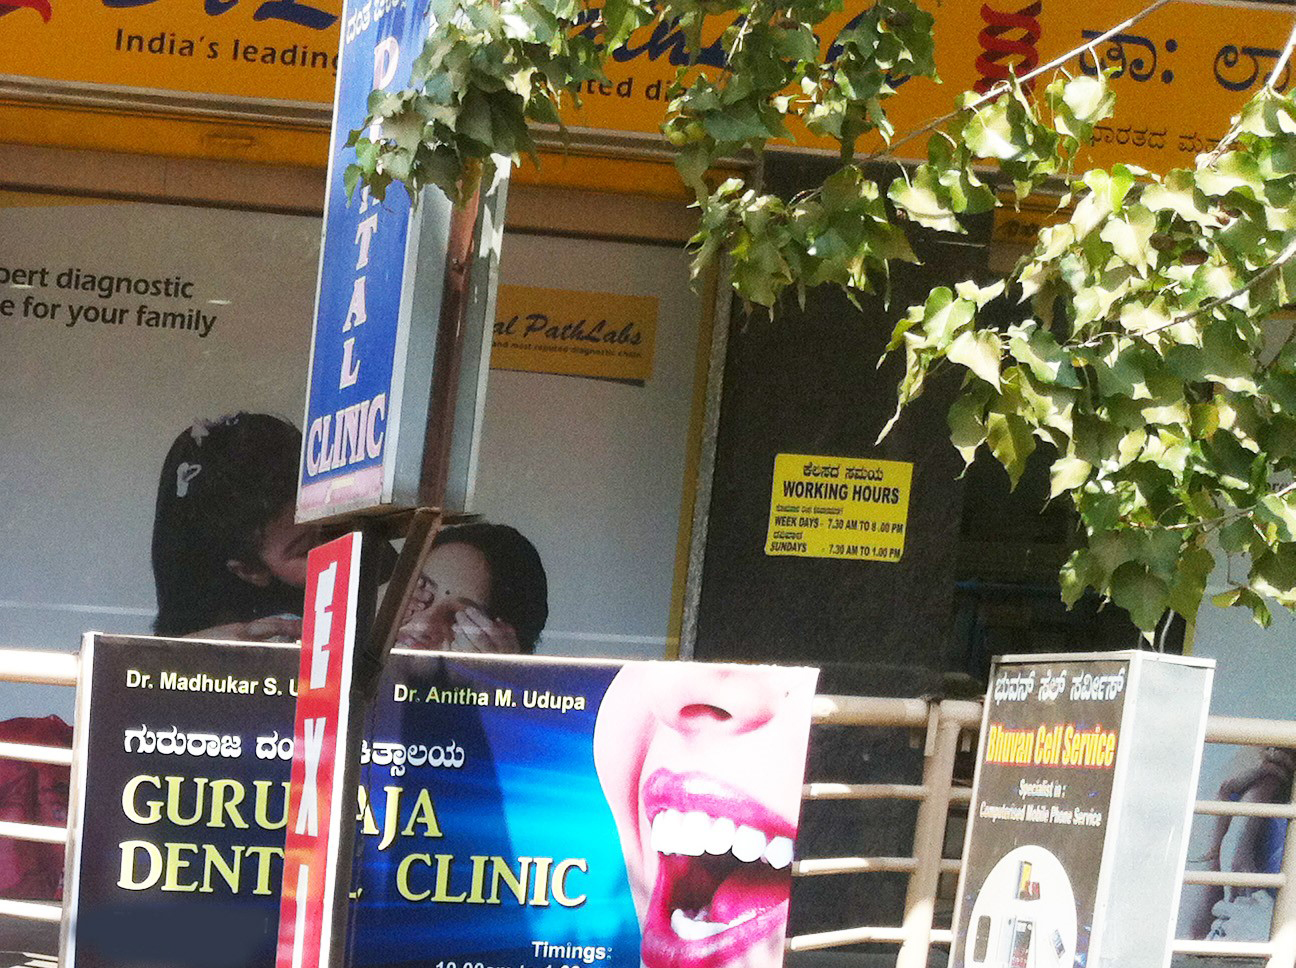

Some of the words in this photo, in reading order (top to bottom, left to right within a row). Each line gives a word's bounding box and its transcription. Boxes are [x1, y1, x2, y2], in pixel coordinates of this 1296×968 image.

[115, 28, 219, 61] India's
[339, 36, 399, 390] DTAL
[56, 268, 195, 299] diagnostic
[23, 296, 61, 320] for
[66, 303, 129, 328] your
[136, 304, 218, 338] family
[492, 315, 519, 335] al
[524, 313, 642, 345] PathLabs
[306, 393, 386, 477] CLINIC
[783, 480, 848, 500] WORKING
[852, 485, 900, 504] HOURS
[775, 516, 797, 527] WEEK
[799, 517, 819, 529] DAYS
[845, 520, 858, 530] AM
[860, 520, 869, 531] TO
[891, 523, 903, 534] PM
[770, 542, 807, 553] SUNDAYS
[126, 669, 154, 689] Dr.
[159, 671, 259, 694] Madhukar
[263, 677, 282, 696] S.
[394, 684, 420, 702] Dr.
[426, 686, 489, 706] Anitha
[495, 689, 517, 708] M.
[523, 691, 585, 713] Udupa
[124, 723, 242, 758] ಗುರುರಾಜ
[255, 730, 294, 761] ದಂ
[985, 724, 1035, 764] Bhuvan
[1034, 725, 1065, 766] Cell
[1062, 725, 1117, 768] Service
[1073, 806, 1102, 827] Service
[396, 853, 588, 907] CLINIC
[532, 941, 612, 963] Timings:
